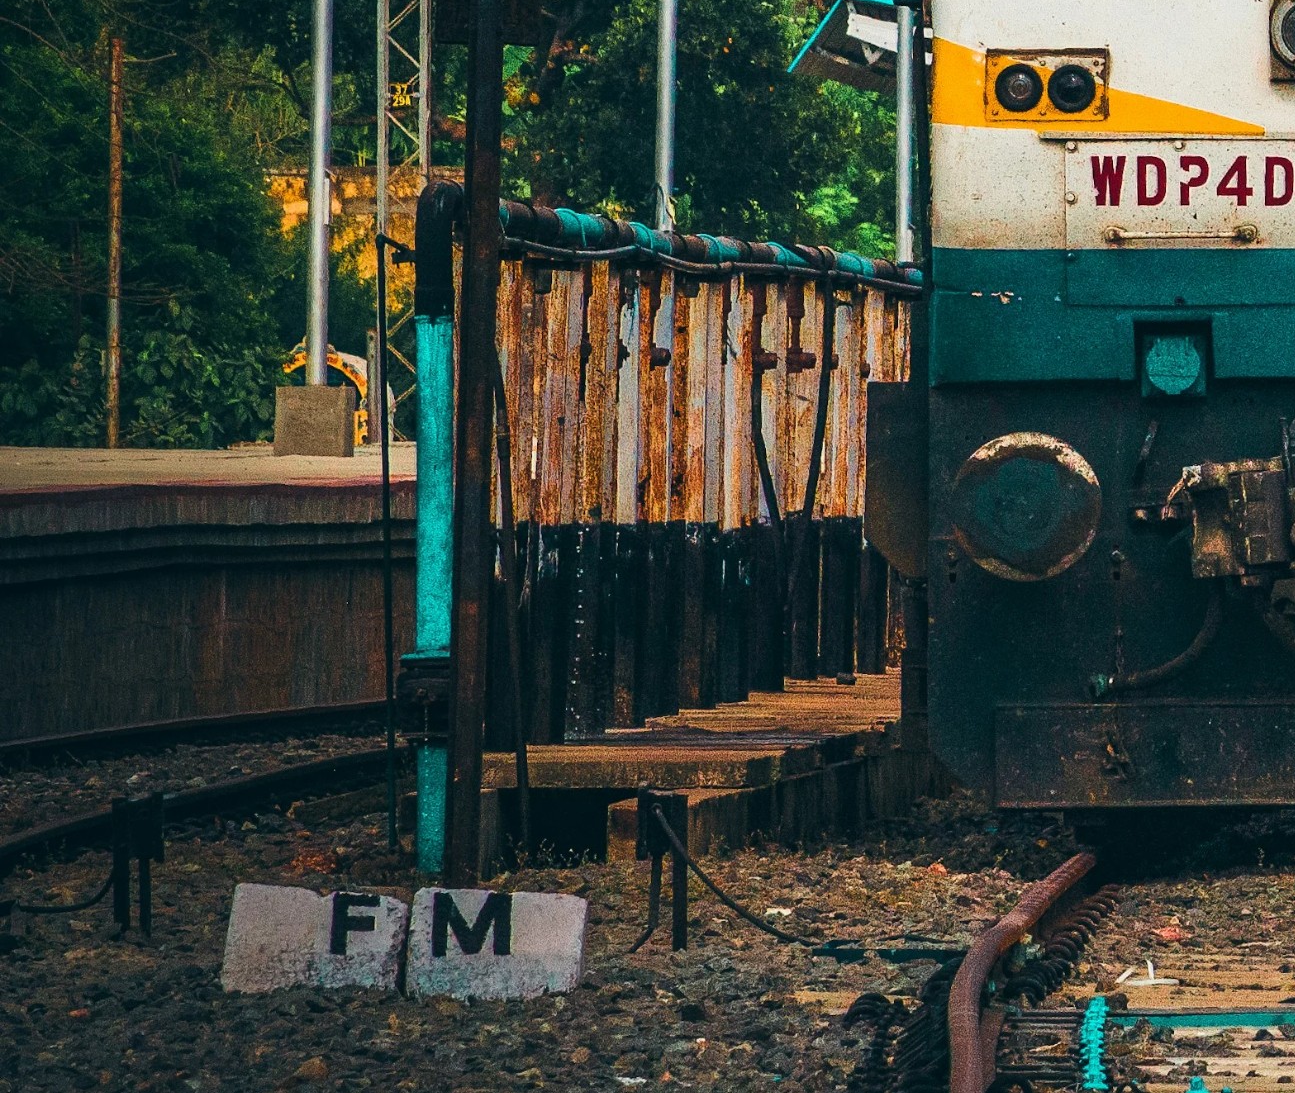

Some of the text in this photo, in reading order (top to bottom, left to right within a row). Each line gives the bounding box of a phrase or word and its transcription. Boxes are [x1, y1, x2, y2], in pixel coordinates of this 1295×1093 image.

[1090, 155, 1295, 207] WDP4D
[330, 892, 513, 957] F M
